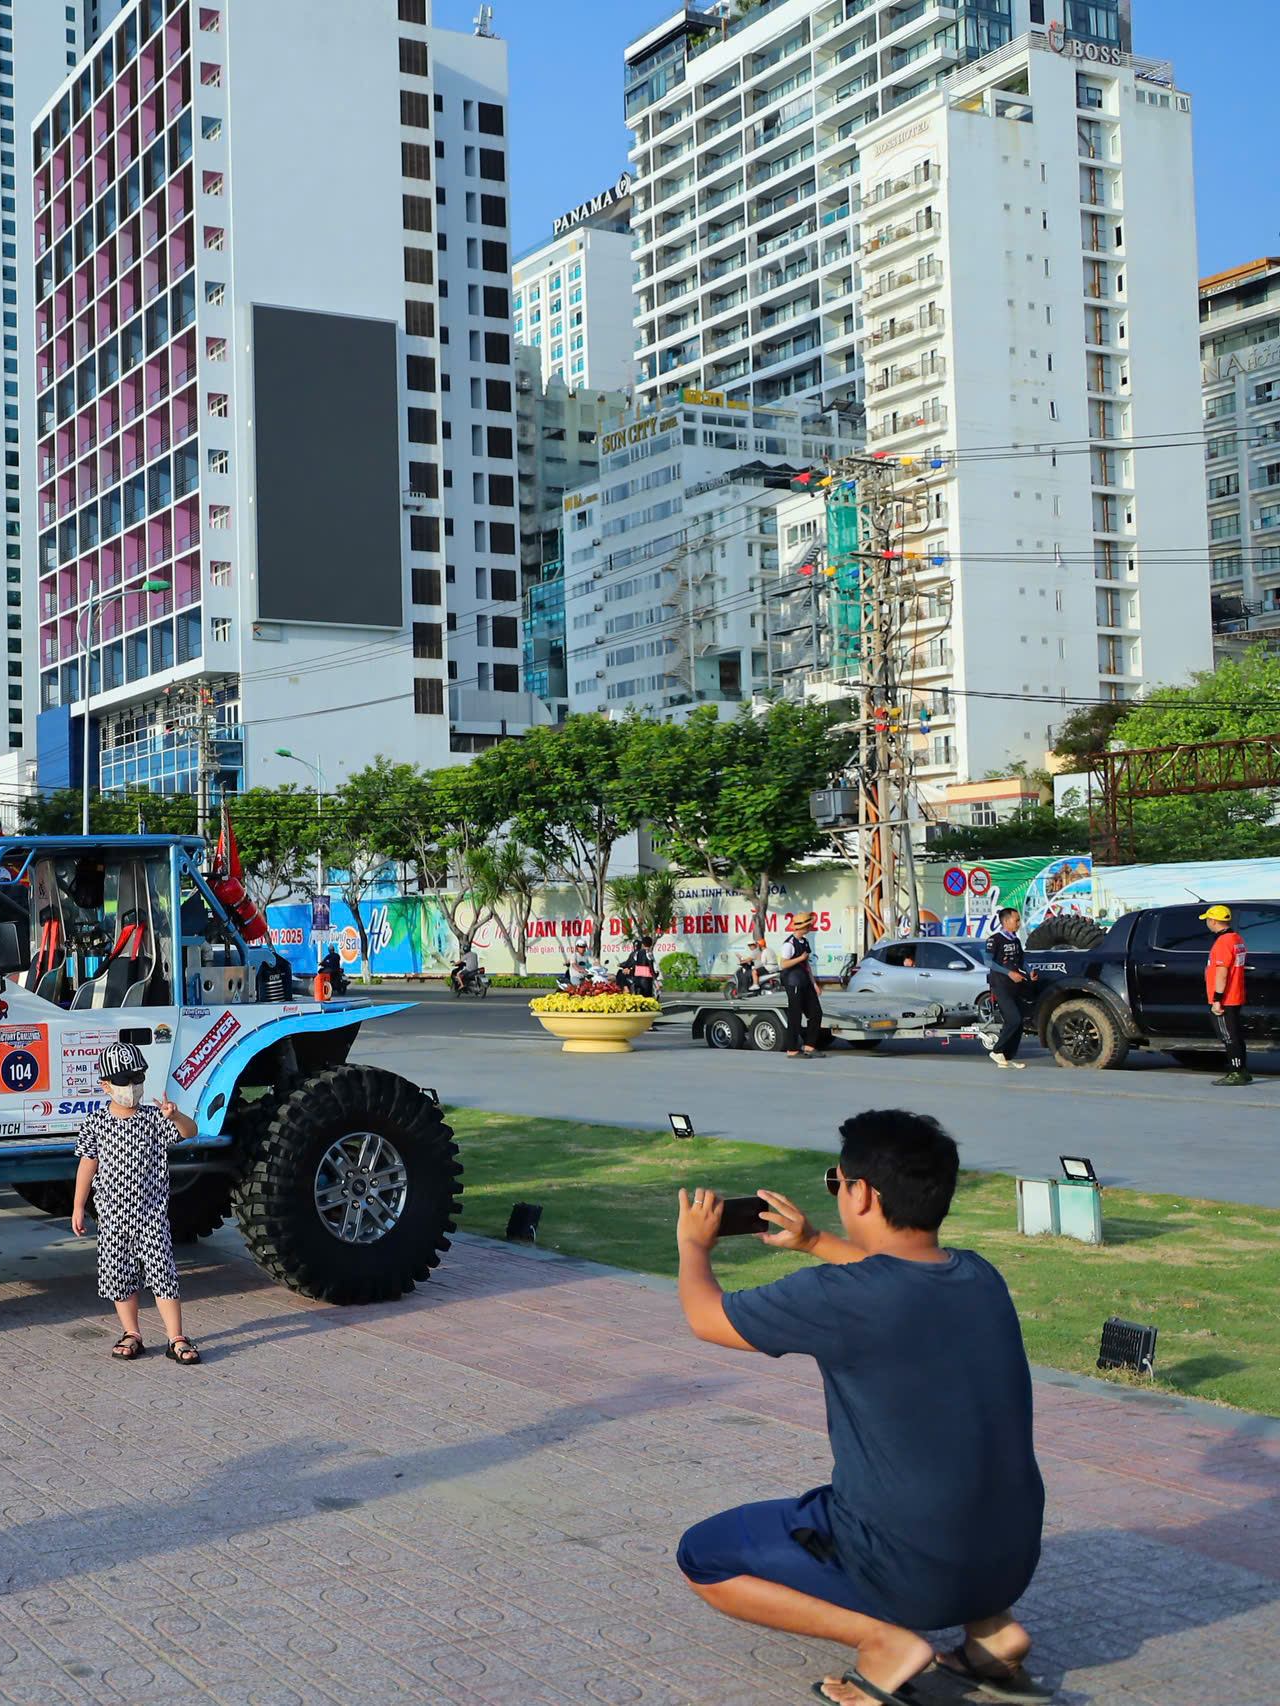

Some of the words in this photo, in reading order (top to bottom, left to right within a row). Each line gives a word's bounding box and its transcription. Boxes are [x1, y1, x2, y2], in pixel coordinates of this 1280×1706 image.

[1072, 39, 1121, 65] BOSS
[552, 190, 613, 236] PANAMA
[602, 428, 627, 456] SUN
[628, 416, 658, 444] CITY
[526, 917, 557, 937] VĂN
[561, 915, 593, 937] HÓA
[683, 906, 729, 935] BIỂN
[784, 911, 832, 933] 225
[281, 928, 303, 944] 2025
[603, 944, 620, 953] 2025
[657, 943, 677, 953] 2025
[63, 1049, 76, 1057] KY
[187, 1015, 236, 1066] WOLVER
[9, 1063, 32, 1081] 104
